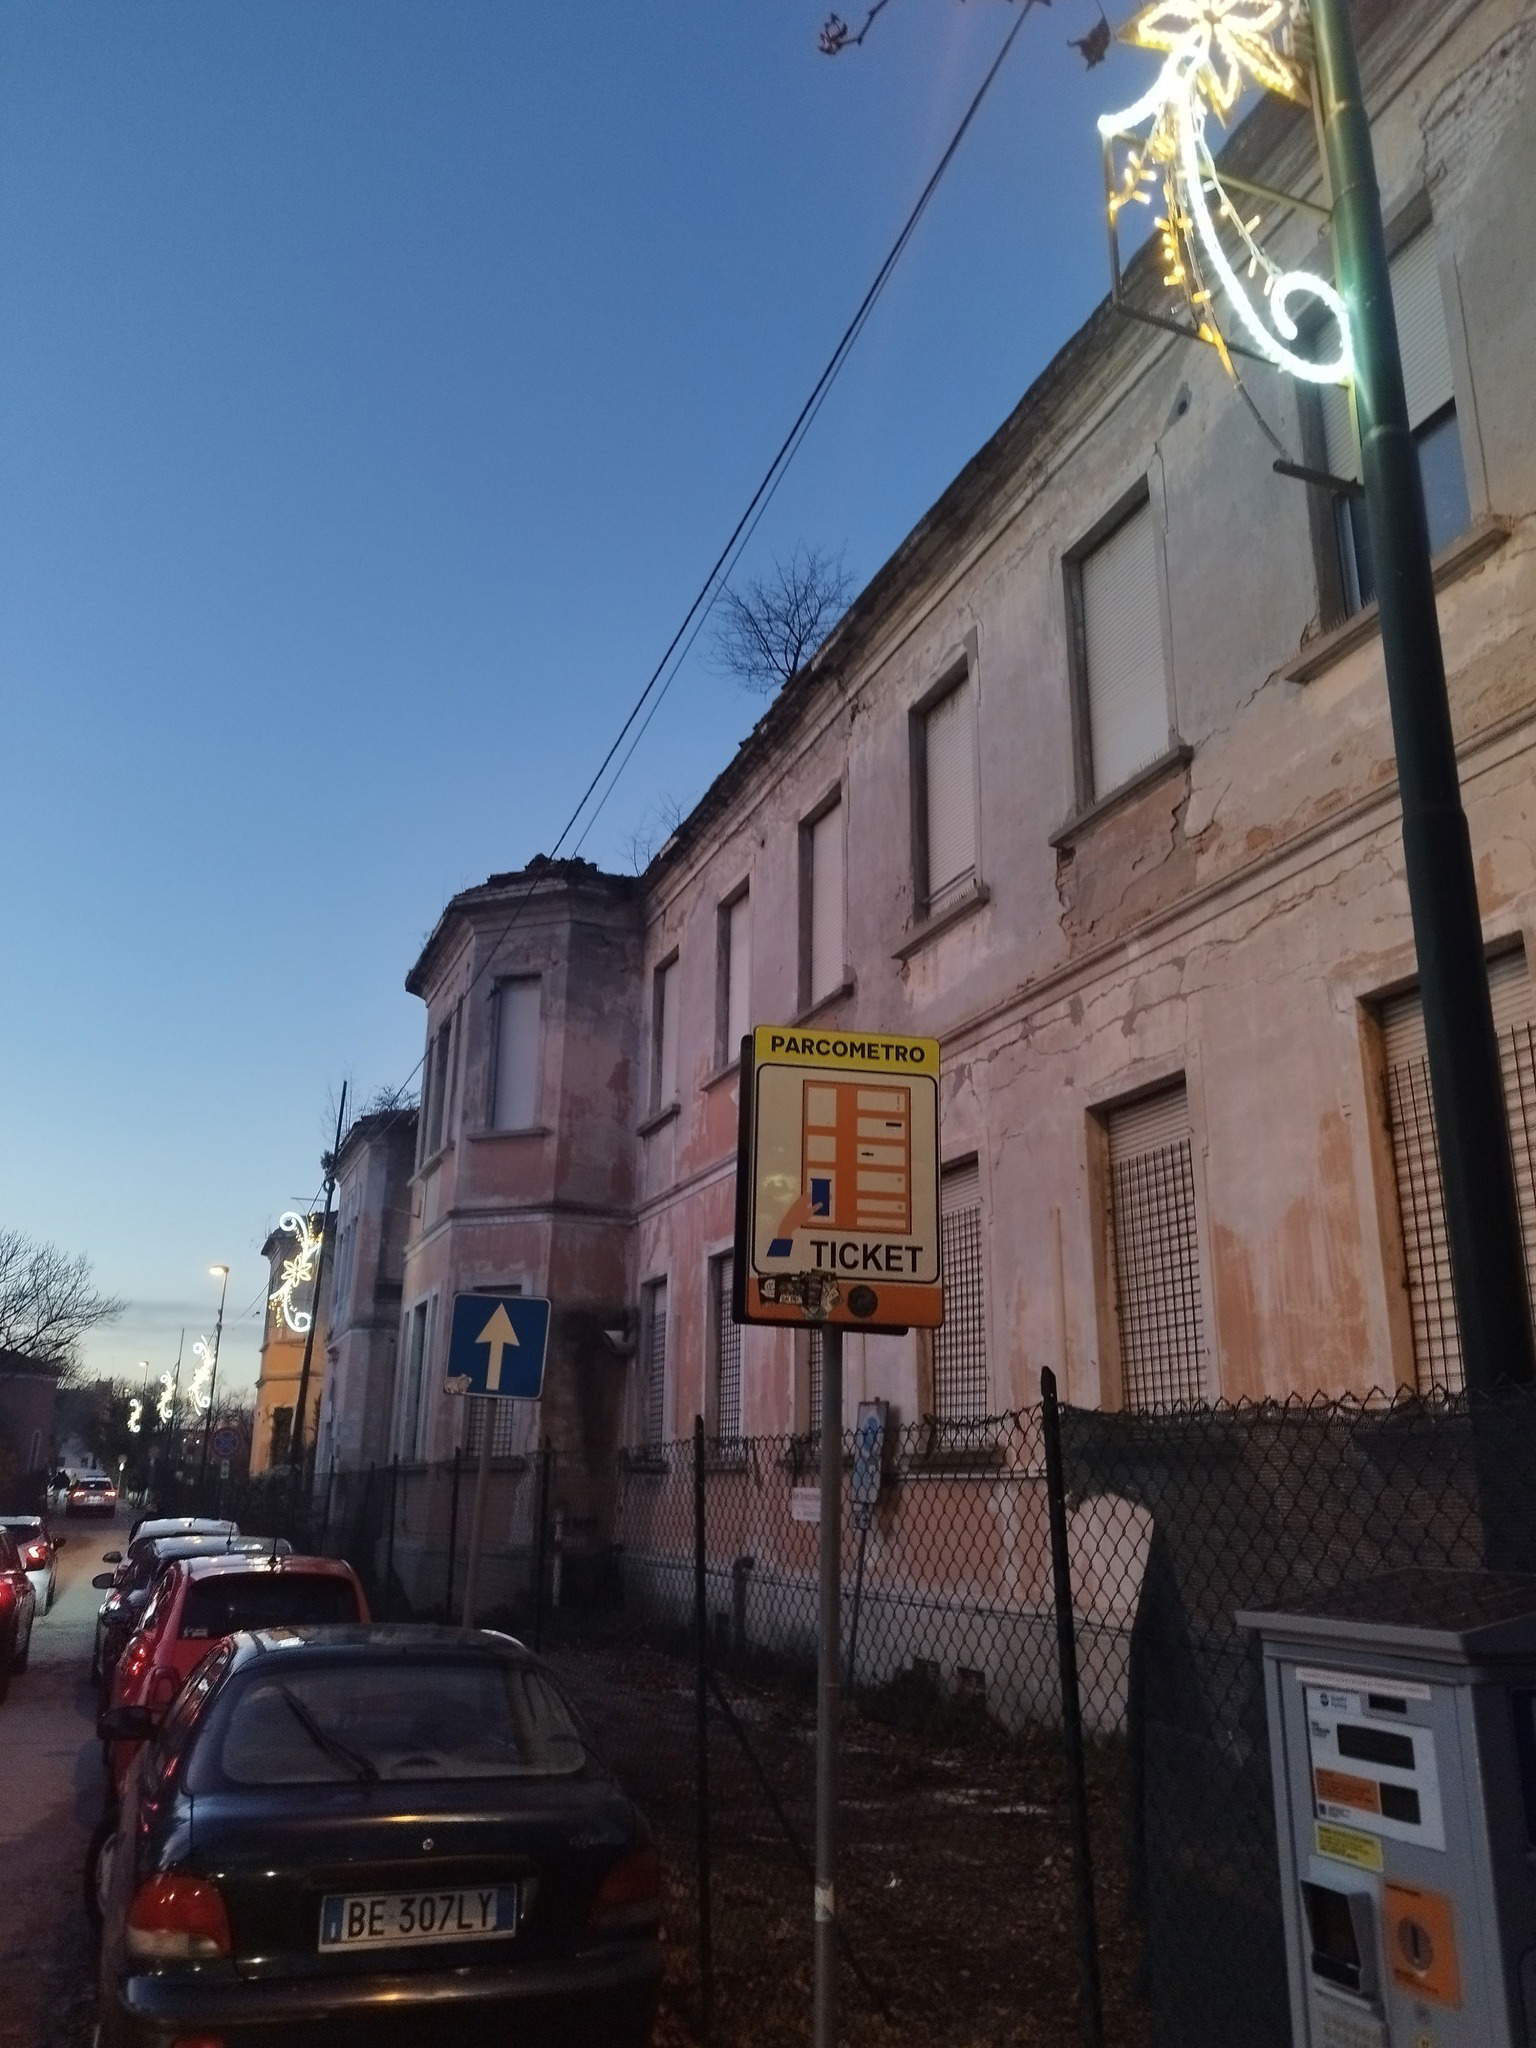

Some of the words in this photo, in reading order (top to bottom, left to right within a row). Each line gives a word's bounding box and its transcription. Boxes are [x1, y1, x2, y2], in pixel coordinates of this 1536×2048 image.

[771, 1036, 925, 1063] PARCOMETRO
[810, 1239, 924, 1274] TICKET
[347, 1900, 386, 1938] BE
